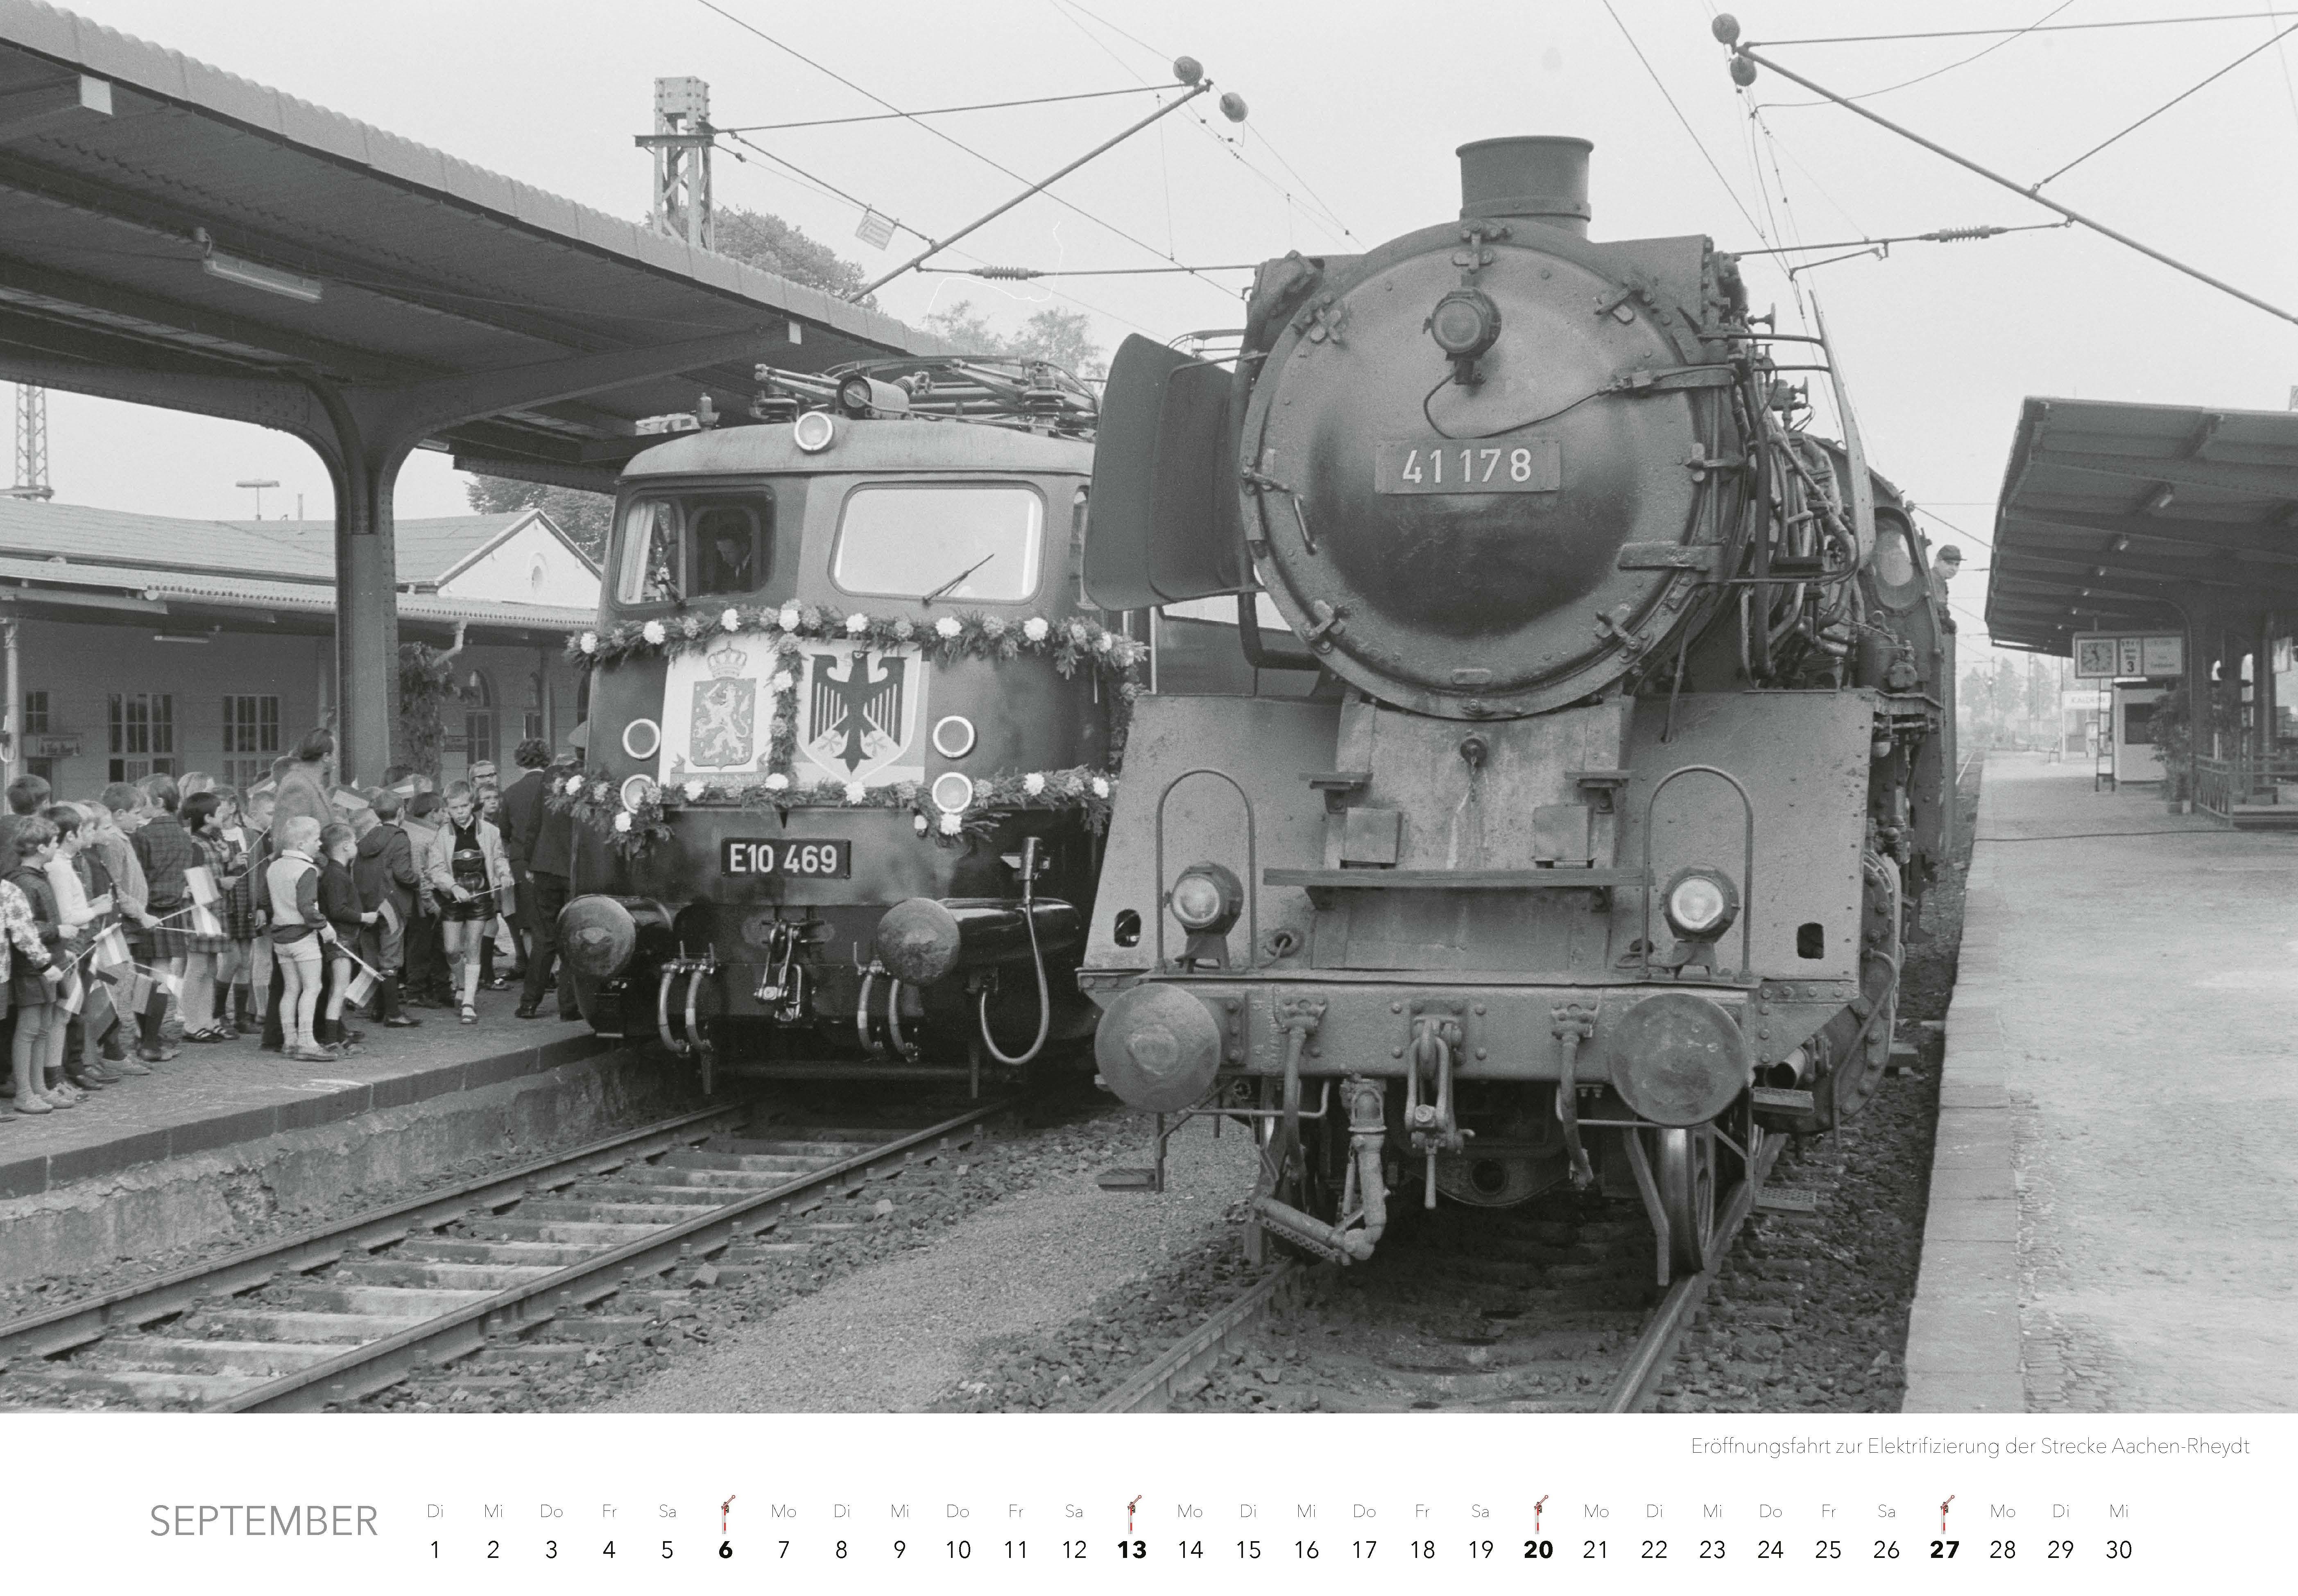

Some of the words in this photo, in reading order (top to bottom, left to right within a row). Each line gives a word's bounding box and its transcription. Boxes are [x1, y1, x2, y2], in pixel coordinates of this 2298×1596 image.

[1402, 450, 1442, 484] 41
[1460, 448, 1531, 482] 178
[2127, 660, 2135, 672] 3
[730, 843, 774, 873] E10
[783, 844, 838, 873] 469
